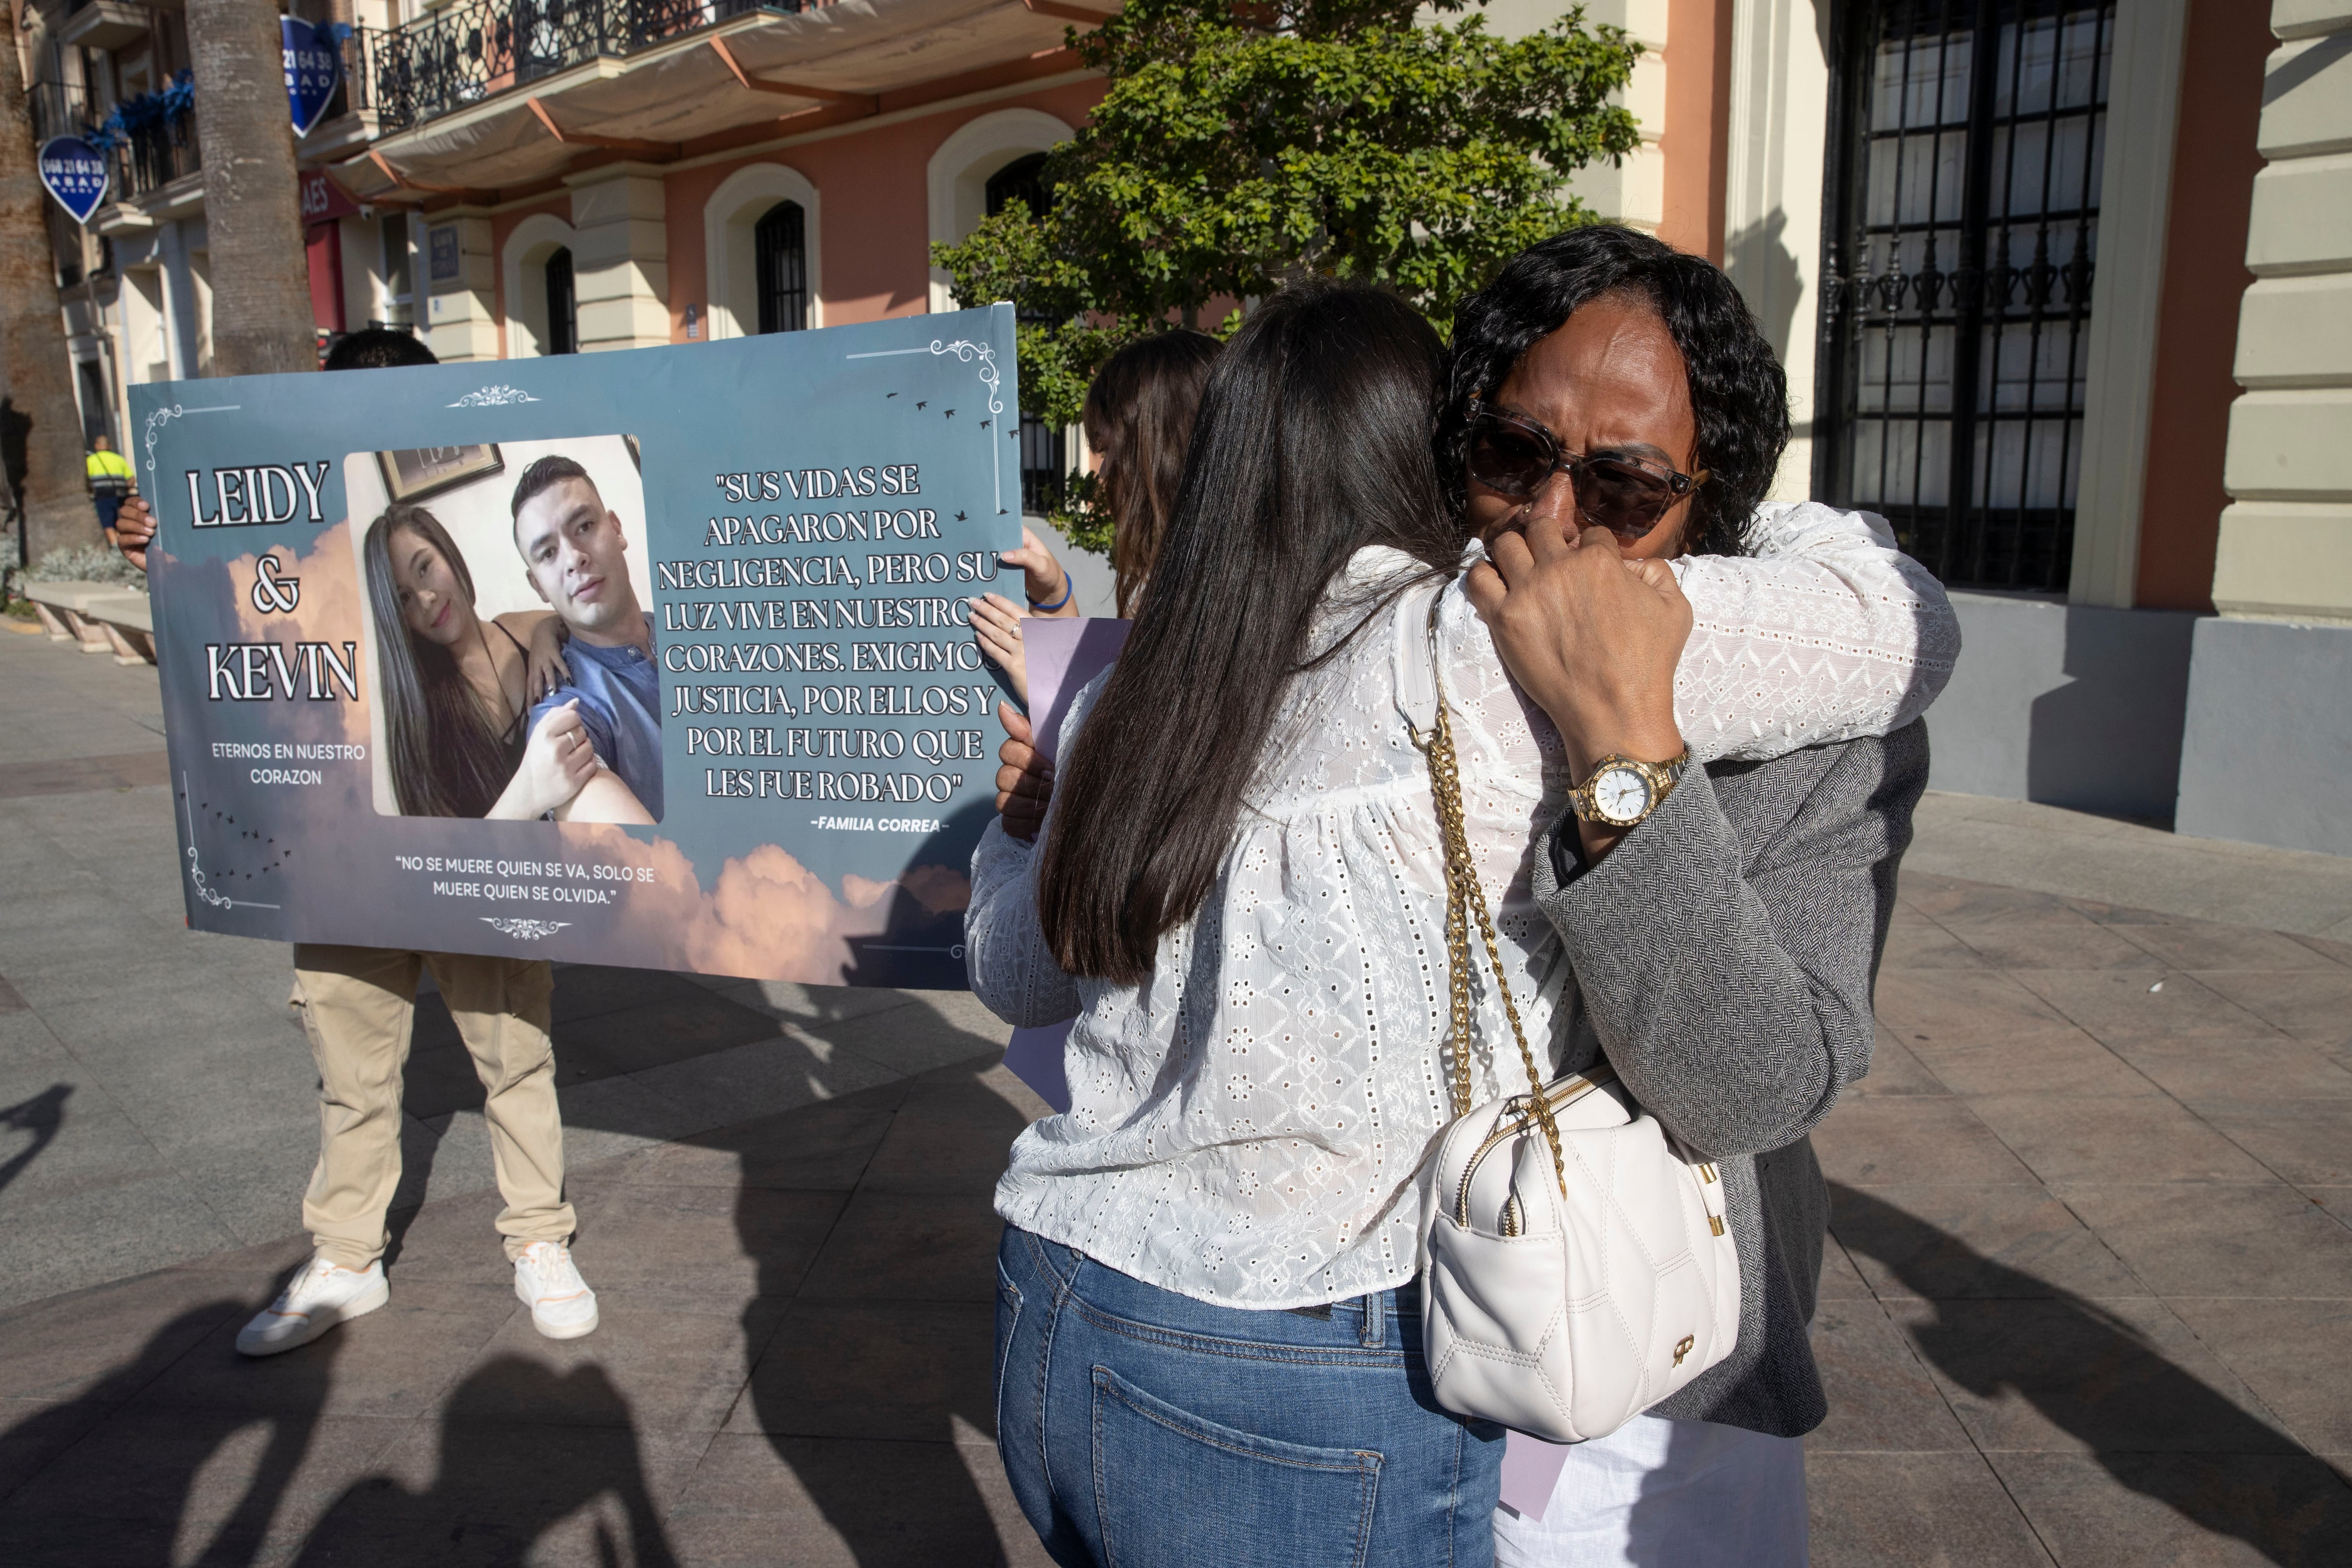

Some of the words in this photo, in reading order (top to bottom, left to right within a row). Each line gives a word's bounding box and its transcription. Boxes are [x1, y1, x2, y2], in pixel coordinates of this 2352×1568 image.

[284, 72, 330, 88] BAD
[50, 175, 103, 188] ABAD
[302, 177, 328, 216] AES
[186, 461, 330, 529] LEIDY
[715, 472, 781, 502] "SUS
[783, 466, 877, 500] VIDAS
[882, 464, 920, 495] SE
[704, 512, 868, 546] APAGARON
[874, 508, 941, 541] POR
[251, 554, 300, 614] &
[658, 556, 862, 590] NEGLIGENCIA,
[867, 552, 951, 584] PERO
[956, 551, 999, 582] SU
[664, 603, 717, 631] LUZ
[719, 601, 786, 630] VIVE
[791, 600, 829, 629] EN
[205, 641, 359, 702] KEVIN
[664, 643, 845, 672] CORAZONES.
[671, 685, 797, 719] JUSTICIA,
[803, 686, 864, 715] POR
[869, 686, 969, 716] ELLOS
[972, 685, 996, 716] Y
[212, 743, 271, 759] ETERNOS
[275, 744, 293, 759] EN
[297, 744, 366, 760] NUESTRO
[686, 726, 746, 756] POR
[748, 728, 783, 756] EL
[787, 729, 905, 758] FUTURO
[911, 729, 984, 766] QUE
[250, 769, 322, 785] CORAZON
[706, 769, 754, 797] LES
[758, 770, 812, 799] FUE
[817, 772, 962, 803] ROBADO"
[810, 816, 875, 831] -FAMILIA
[396, 855, 423, 870] “NO
[426, 857, 443, 872] SE
[445, 859, 493, 874] MUERE
[496, 860, 542, 878] QUIEN
[545, 862, 563, 878] SE
[565, 863, 590, 881] VA,
[593, 865, 633, 881] SOLO
[636, 868, 655, 883] SE
[433, 881, 481, 897] MUERE
[483, 883, 529, 901] QUIEN
[532, 885, 549, 901] SE
